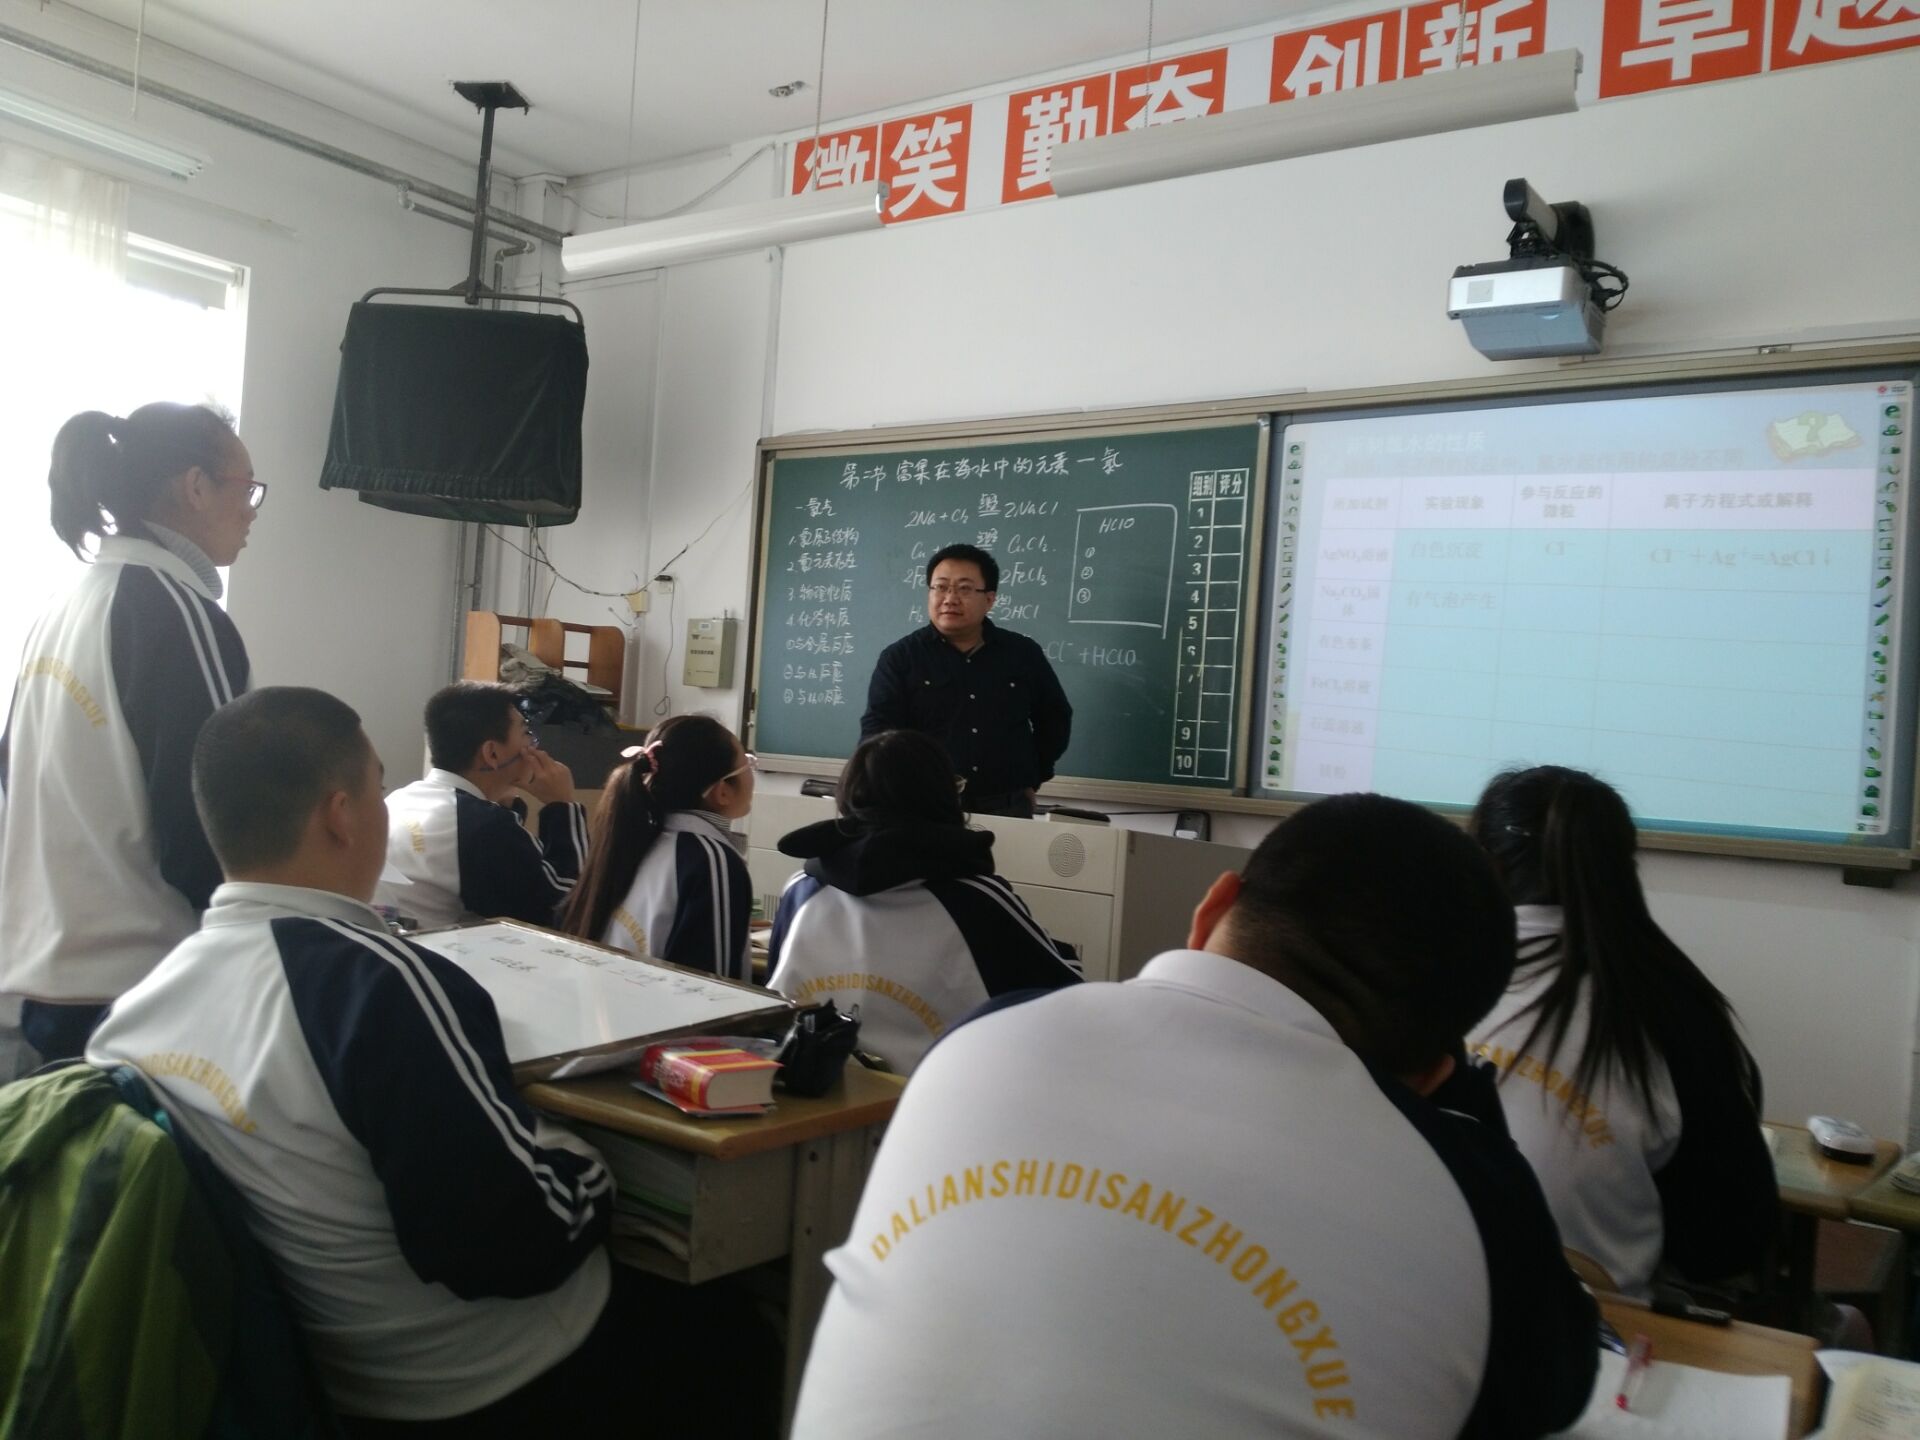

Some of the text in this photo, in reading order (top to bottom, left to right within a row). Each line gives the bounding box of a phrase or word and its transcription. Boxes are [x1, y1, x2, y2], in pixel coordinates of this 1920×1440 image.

[803, 116, 963, 218] 微笑
[840, 462, 887, 492] 第二节
[1219, 473, 1242, 495] 评分
[1193, 475, 1213, 496] 组别
[1520, 485, 1604, 502] 参与反应的
[1197, 508, 1204, 518] 1
[1194, 535, 1203, 549] 2
[1192, 563, 1201, 575] 3
[1190, 590, 1200, 604] 4
[1188, 616, 1197, 630] 5
[1181, 727, 1191, 740] 9
[1176, 755, 1192, 769] 10
[869, 1158, 1358, 1422] DALIANSHIDISANZHONGXUE
